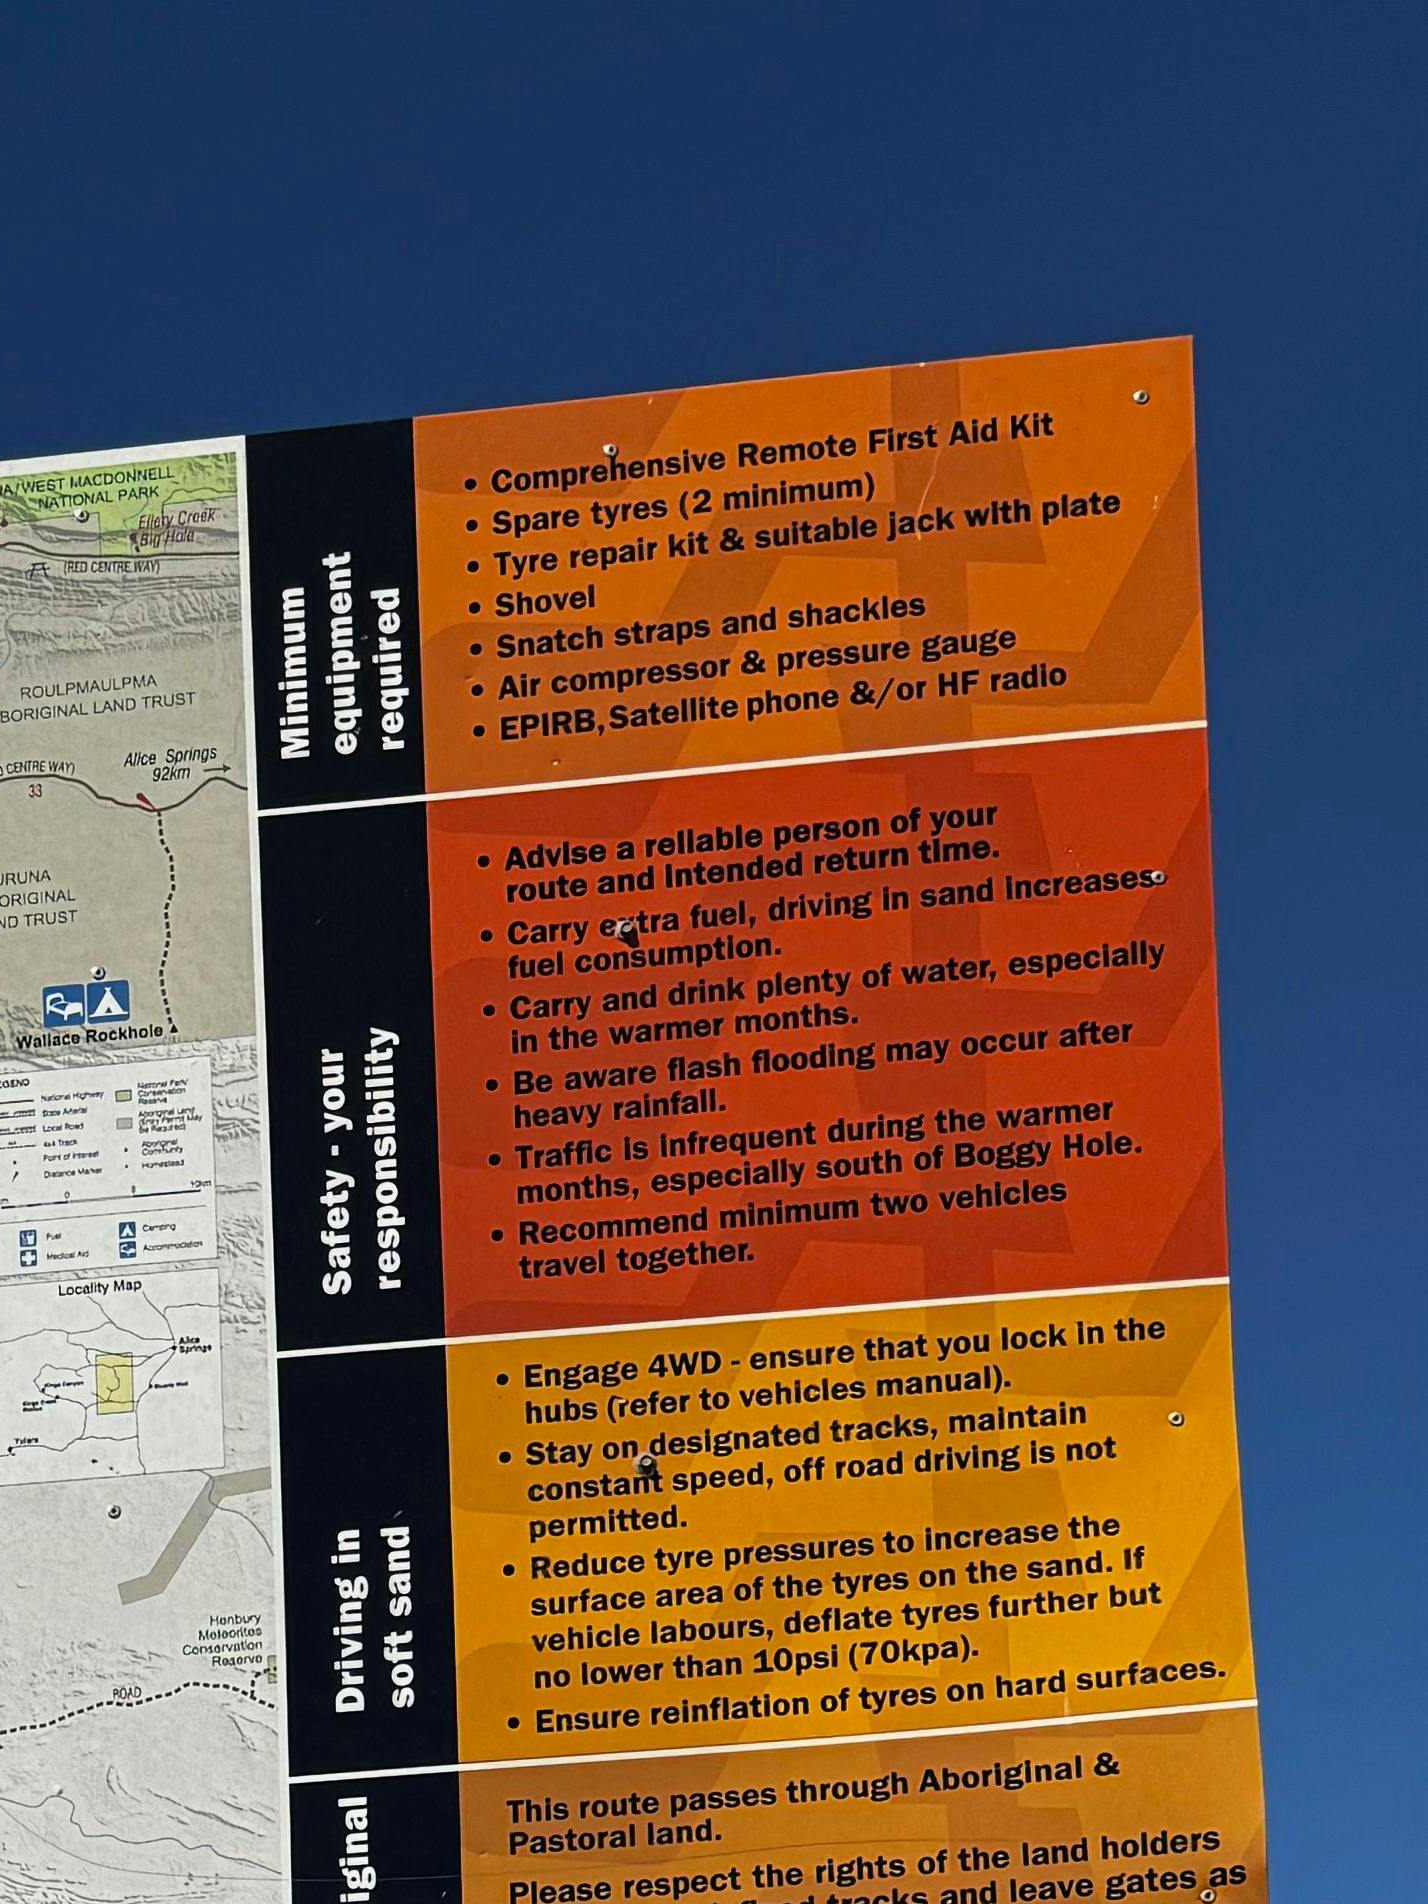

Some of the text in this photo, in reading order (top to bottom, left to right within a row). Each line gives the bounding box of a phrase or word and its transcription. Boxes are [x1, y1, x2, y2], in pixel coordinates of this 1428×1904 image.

[493, 472, 874, 538] Spare tyres (2 minimum)
[496, 584, 594, 617] Shovel
[278, 588, 309, 759] Minimum
[322, 552, 362, 754] equipment
[370, 588, 409, 750] required
[124, 748, 218, 767] Alice Springs
[153, 762, 190, 782] 92km
[17, 1024, 164, 1051] Wallace Rockhole
[322, 1049, 353, 1133] your
[515, 1088, 726, 1128] heavy rainfall.
[364, 1028, 405, 1289] responsibility
[320, 1170, 355, 1294] Safety
[114, 1280, 142, 1292] Map
[331, 1530, 368, 1712] Driving in
[380, 1527, 414, 1708] soft sand
[510, 1818, 721, 1855] Pastoral land.
